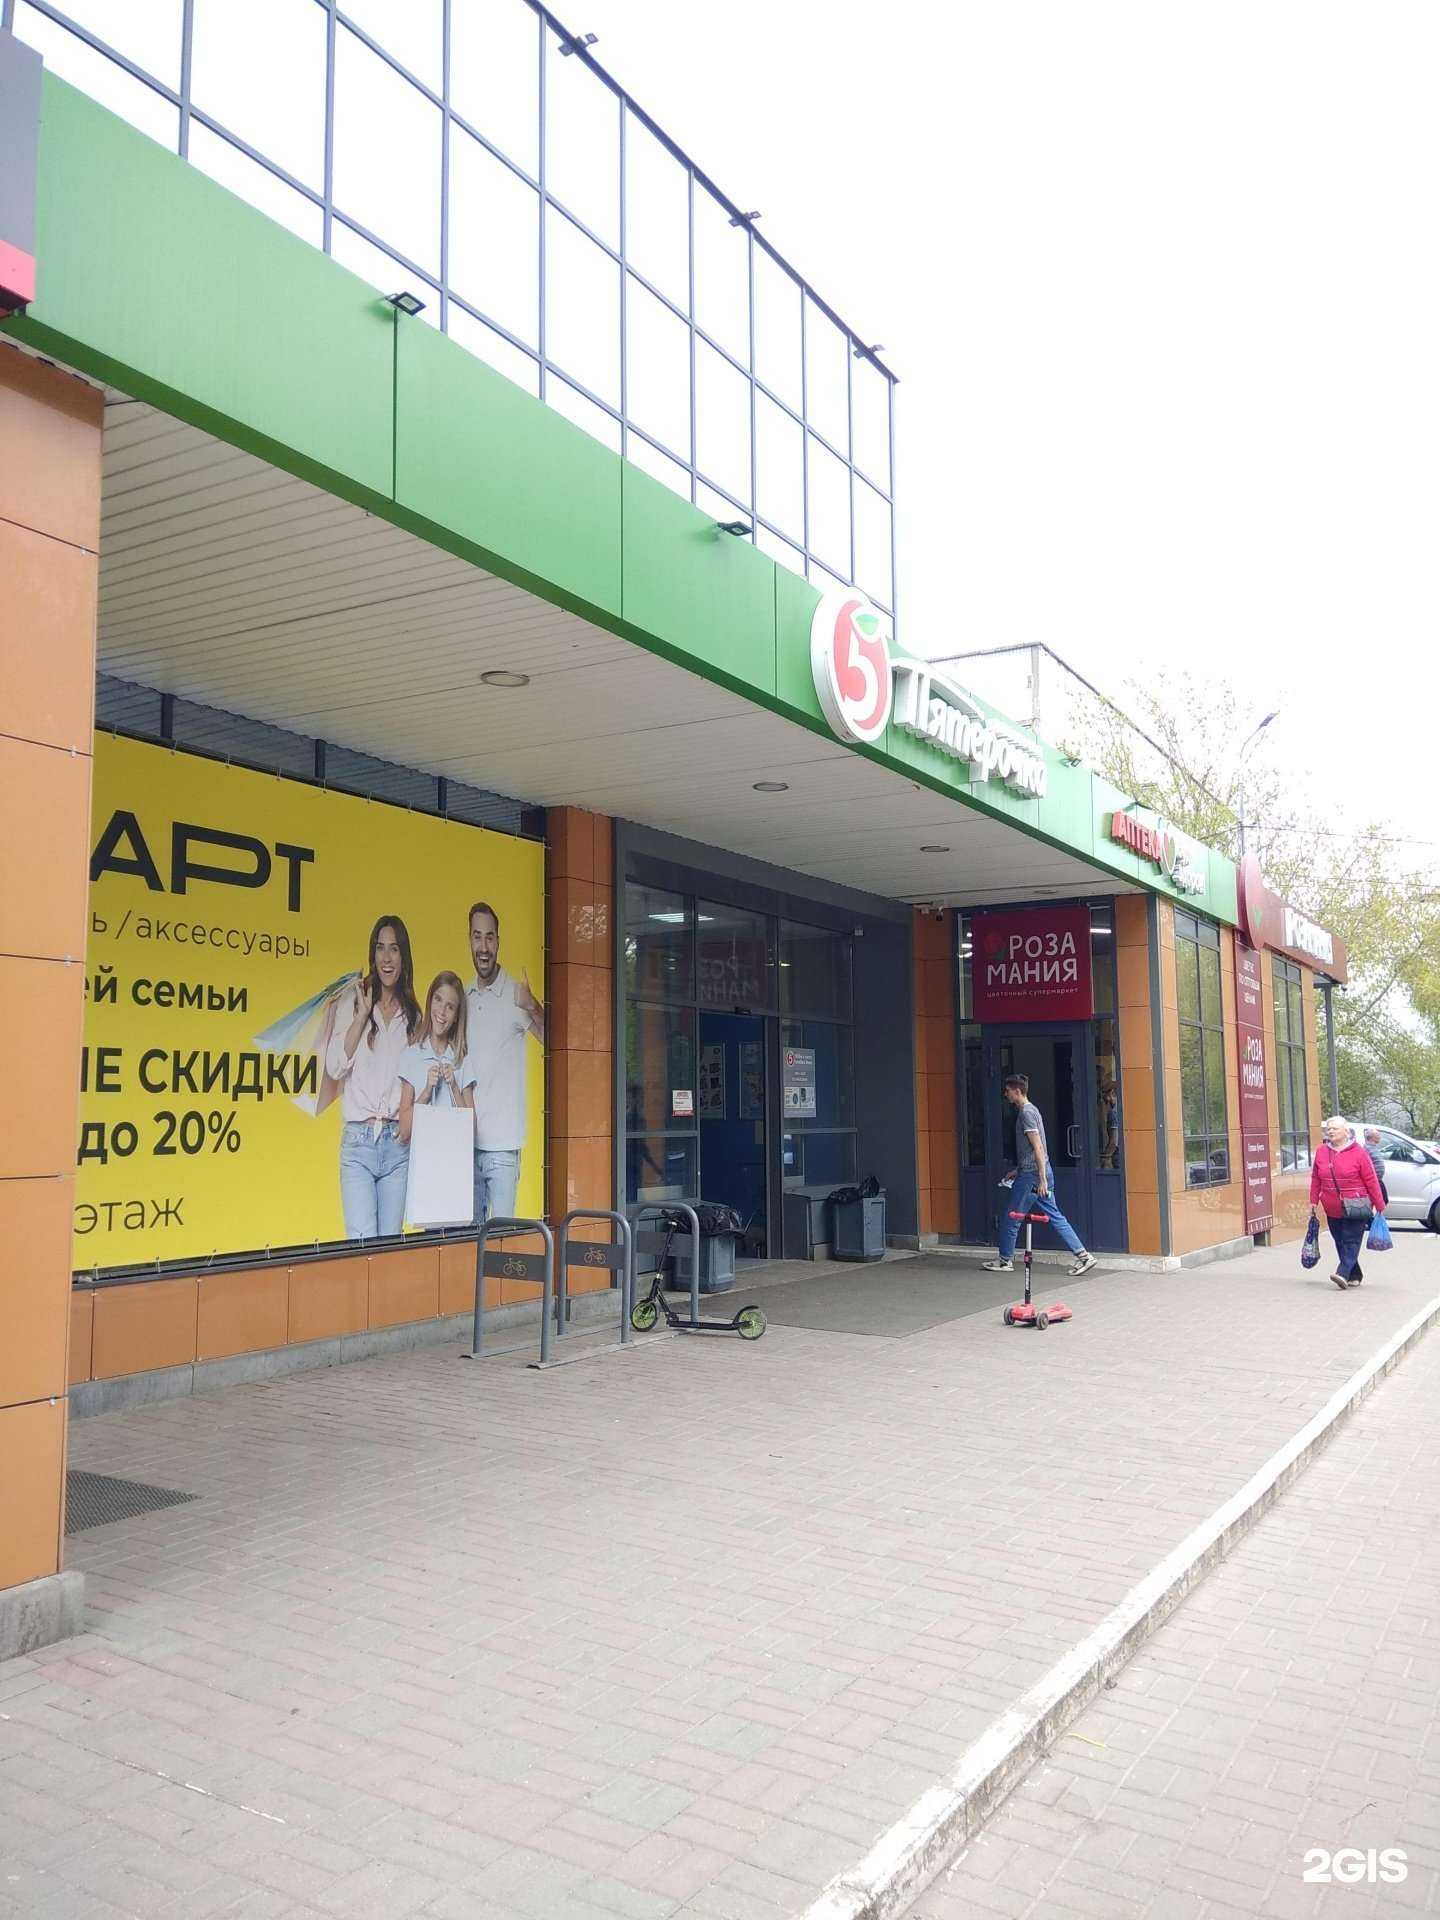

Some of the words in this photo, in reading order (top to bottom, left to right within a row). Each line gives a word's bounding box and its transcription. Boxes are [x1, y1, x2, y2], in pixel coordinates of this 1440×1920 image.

[1008, 932, 1076, 960] РОЗА
[986, 958, 1078, 986] МАНИЯ
[131, 979, 248, 1013] семьи
[1247, 1036, 1263, 1062] РОЗА
[138, 1048, 318, 1102] СКИДКИ
[77, 1121, 139, 1166] до
[152, 1110, 241, 1156] 20%
[73, 1196, 185, 1235] этаж
